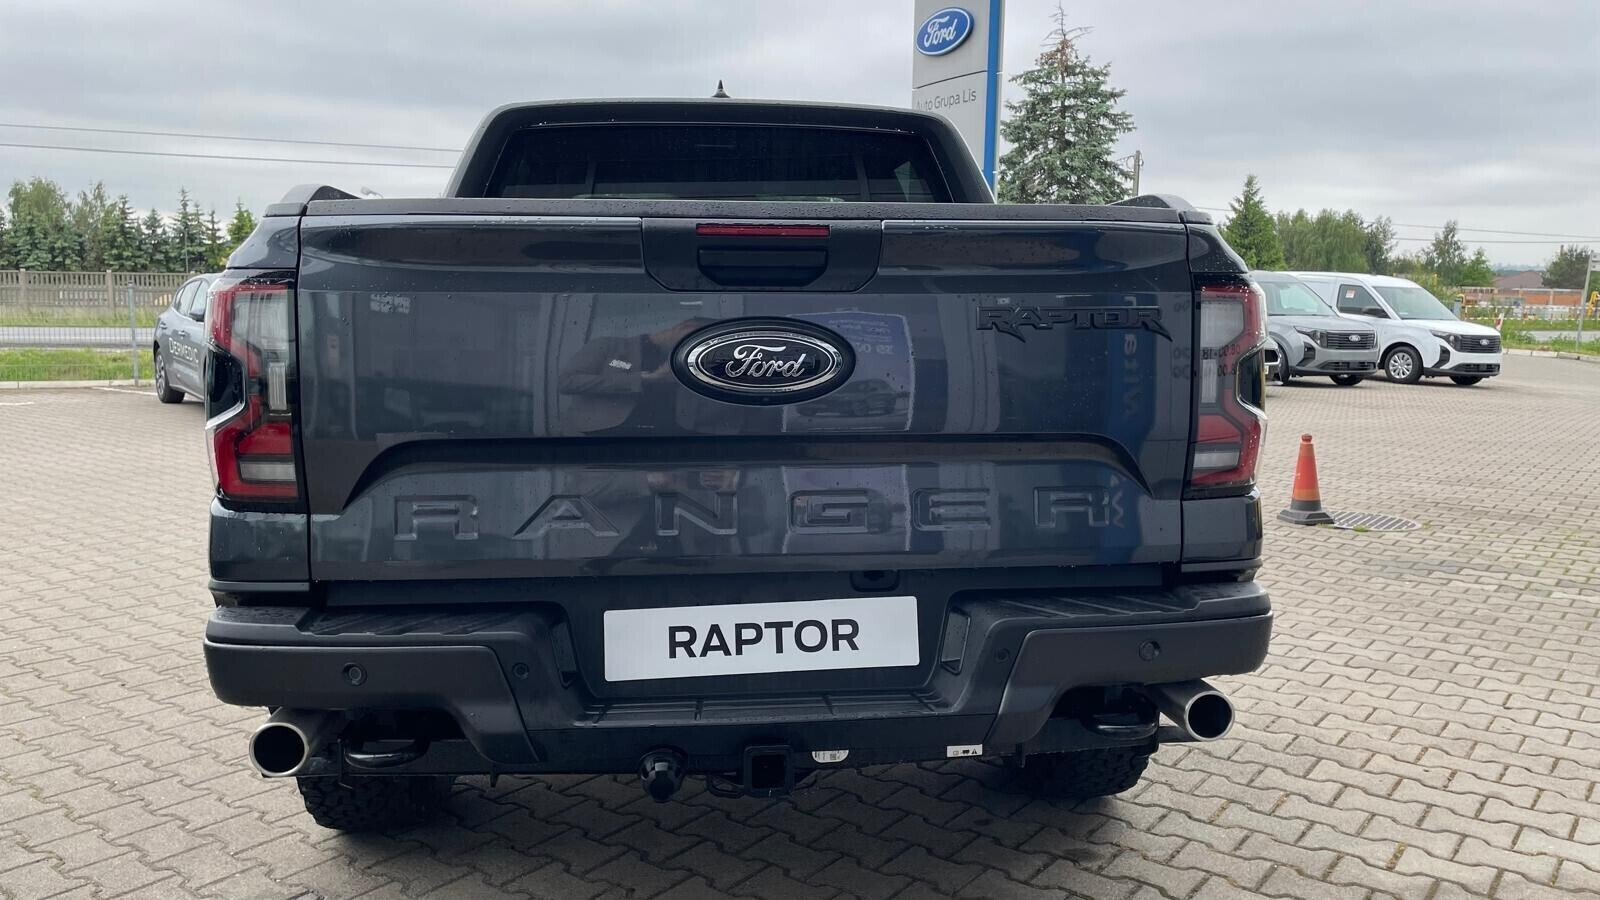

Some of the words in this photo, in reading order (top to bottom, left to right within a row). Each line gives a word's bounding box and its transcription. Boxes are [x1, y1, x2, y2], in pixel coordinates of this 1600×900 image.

[924, 15, 958, 48] Ford
[934, 94, 960, 109] Grupa
[963, 88, 977, 103] Lis
[976, 305, 1173, 343] RAPTOR
[725, 344, 806, 377] Ford
[393, 487, 1111, 541] RANGER
[668, 618, 860, 659] RAPTOR
